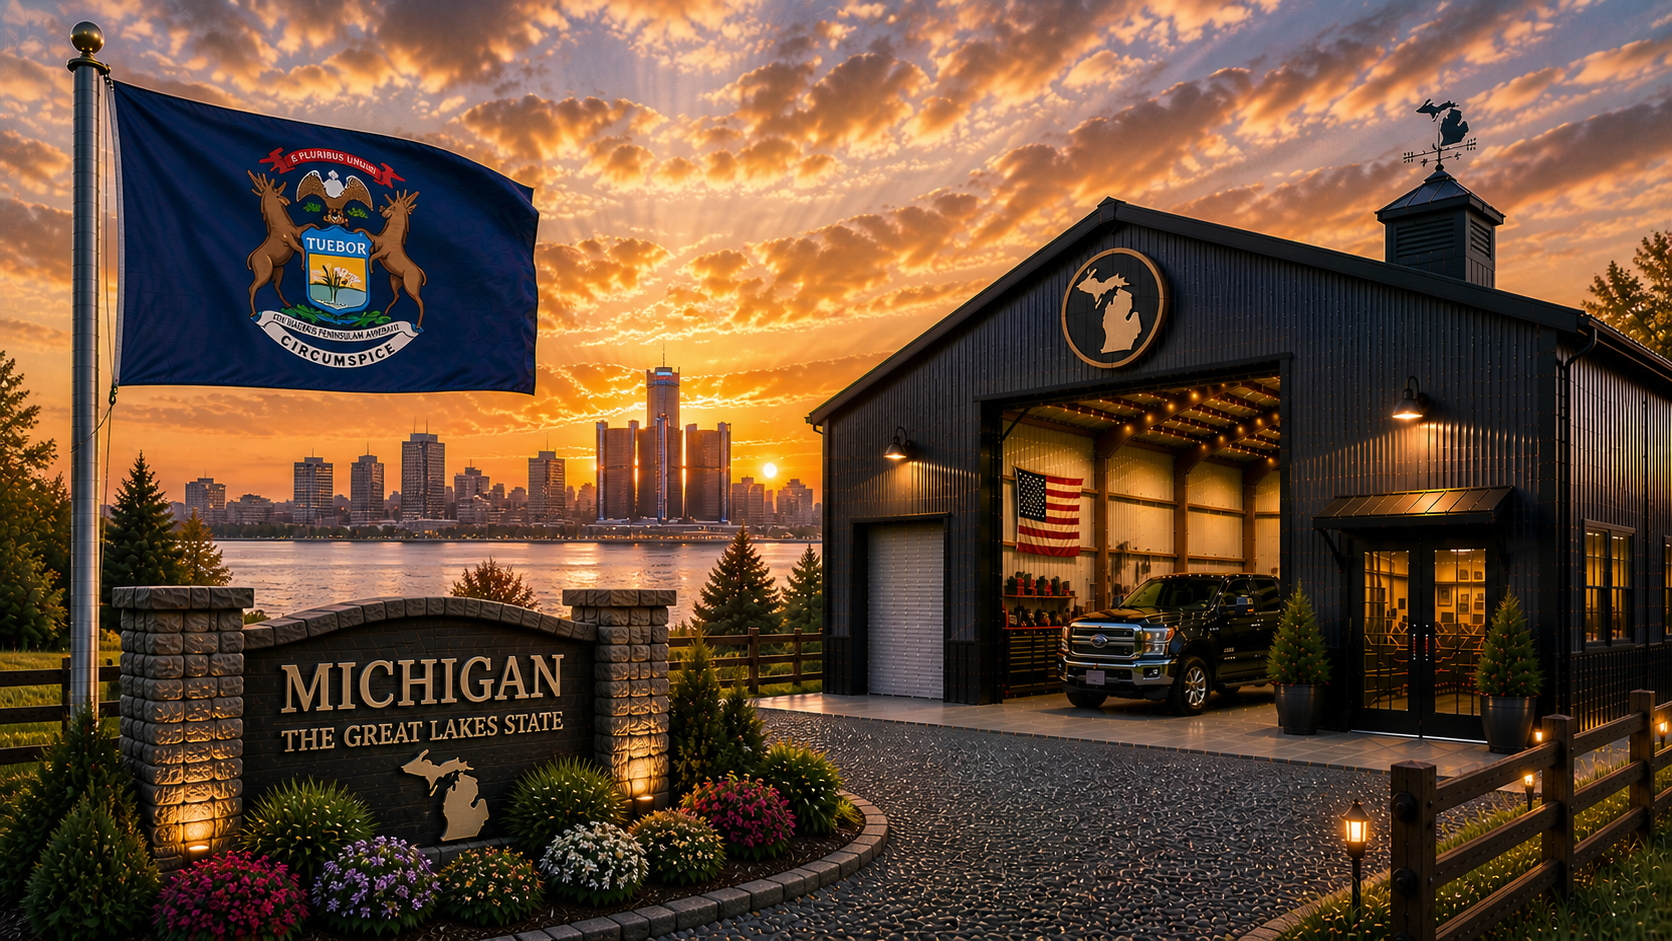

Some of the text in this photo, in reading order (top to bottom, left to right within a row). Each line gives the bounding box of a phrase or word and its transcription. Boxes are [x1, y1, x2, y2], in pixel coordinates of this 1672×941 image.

[291, 154, 298, 163] E
[299, 150, 344, 161] PLURIBUS
[306, 237, 367, 255] TUEBOR
[280, 335, 396, 366] CIRCUMSPICE
[281, 654, 565, 714] MICHIGAN
[281, 711, 564, 753] THE GREAT LAKES STATE
